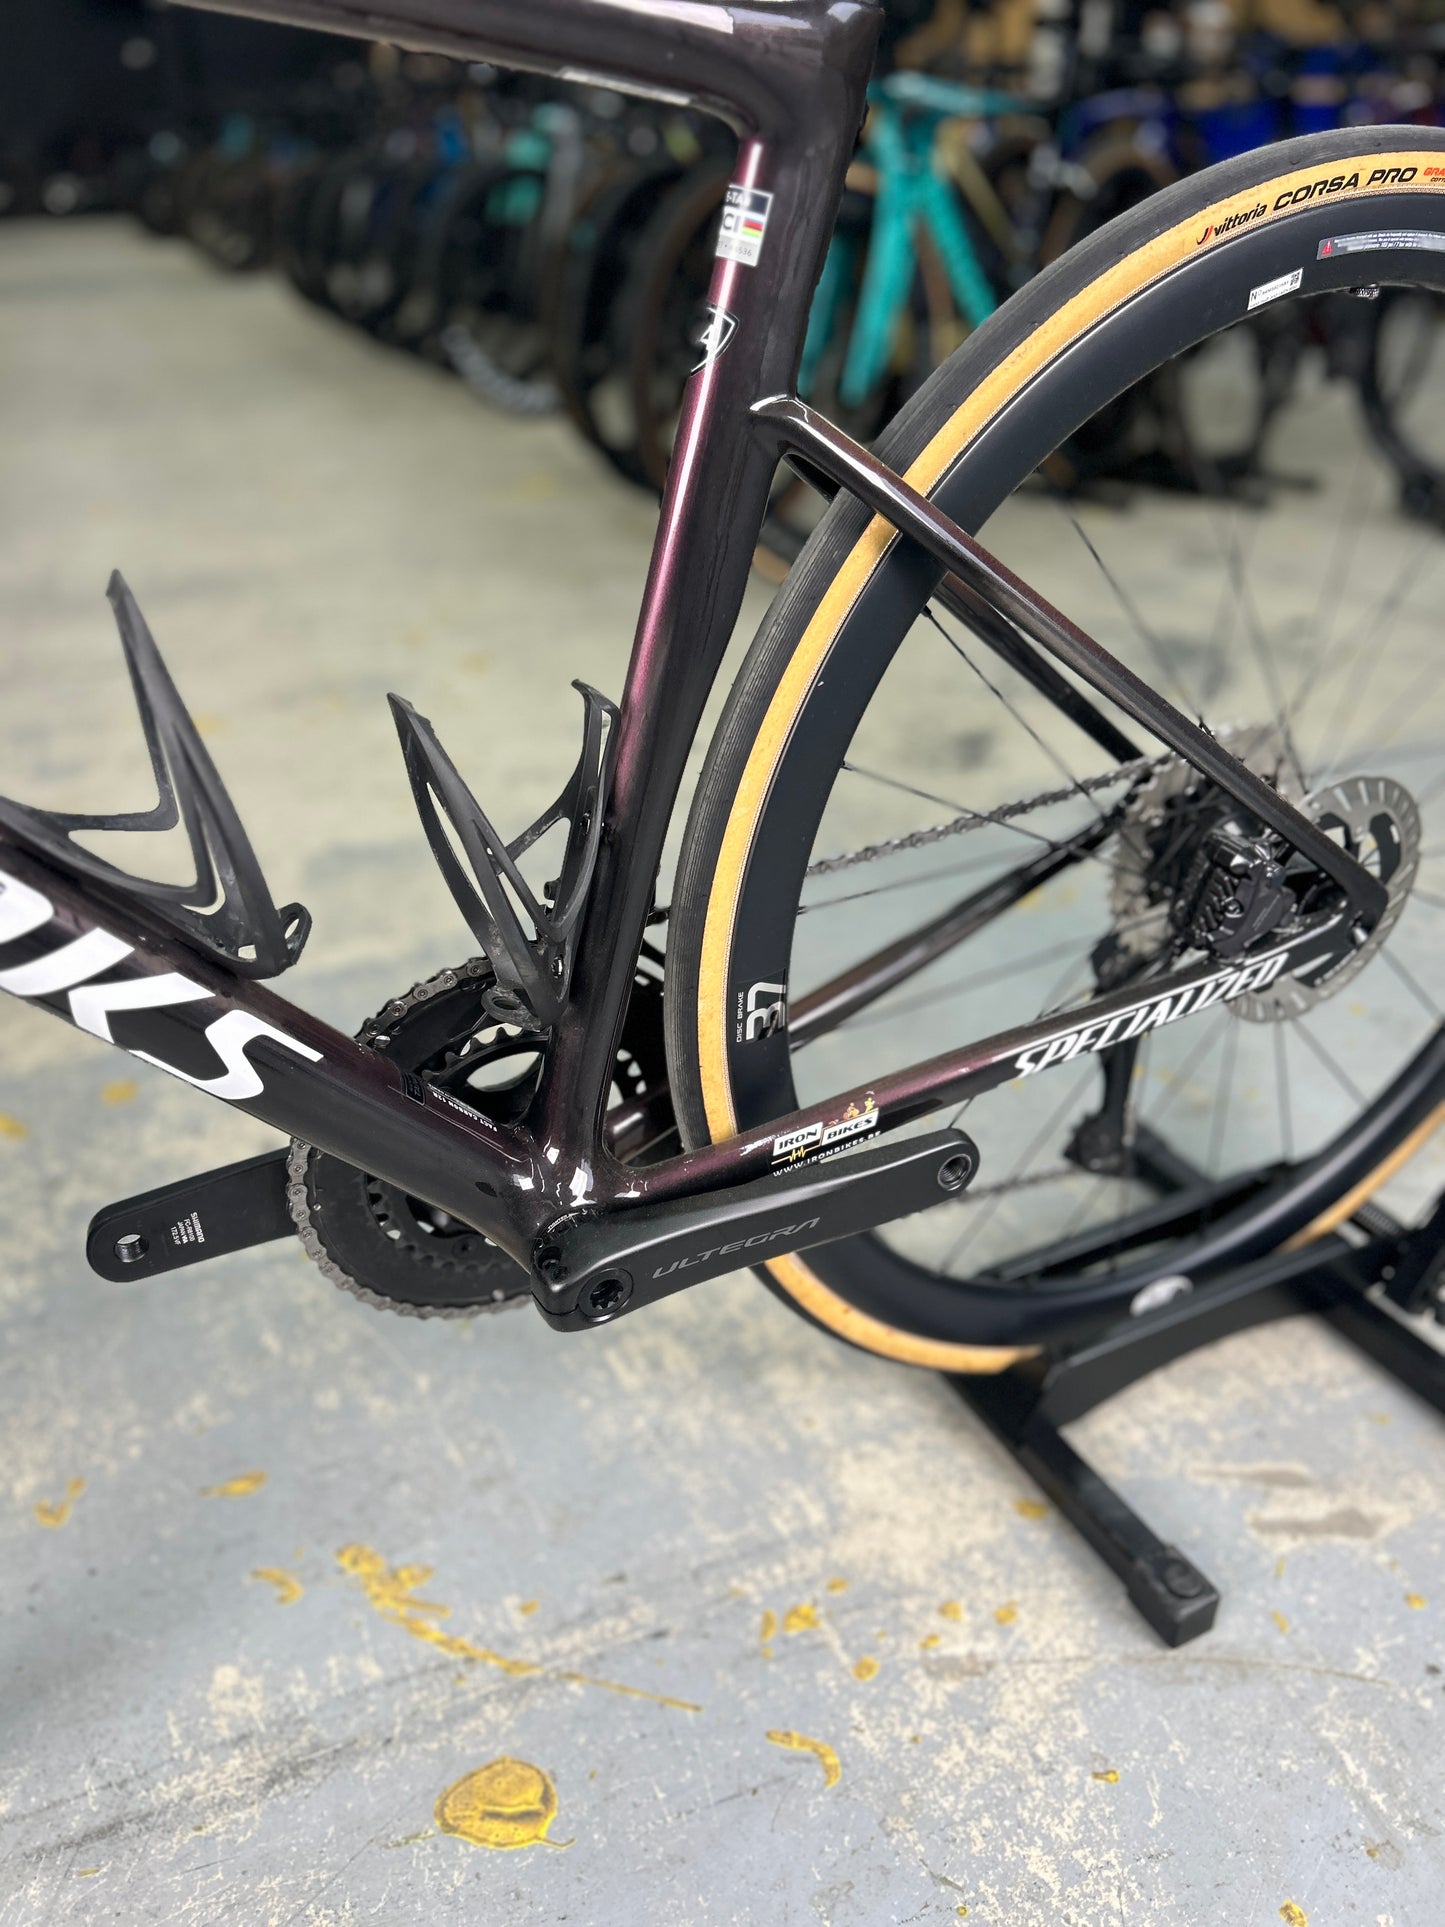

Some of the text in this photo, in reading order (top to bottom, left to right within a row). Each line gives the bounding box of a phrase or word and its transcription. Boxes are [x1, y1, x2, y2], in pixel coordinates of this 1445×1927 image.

[1214, 167, 1417, 236] vittoria CORSA PRO
[746, 981, 786, 1041] 37
[1014, 952, 1289, 1078] SPECIALIZED
[778, 1117, 873, 1150] IRON BIKES
[190, 1211, 205, 1243] SHIMANO
[652, 1216, 821, 1279] ULTEGRA
